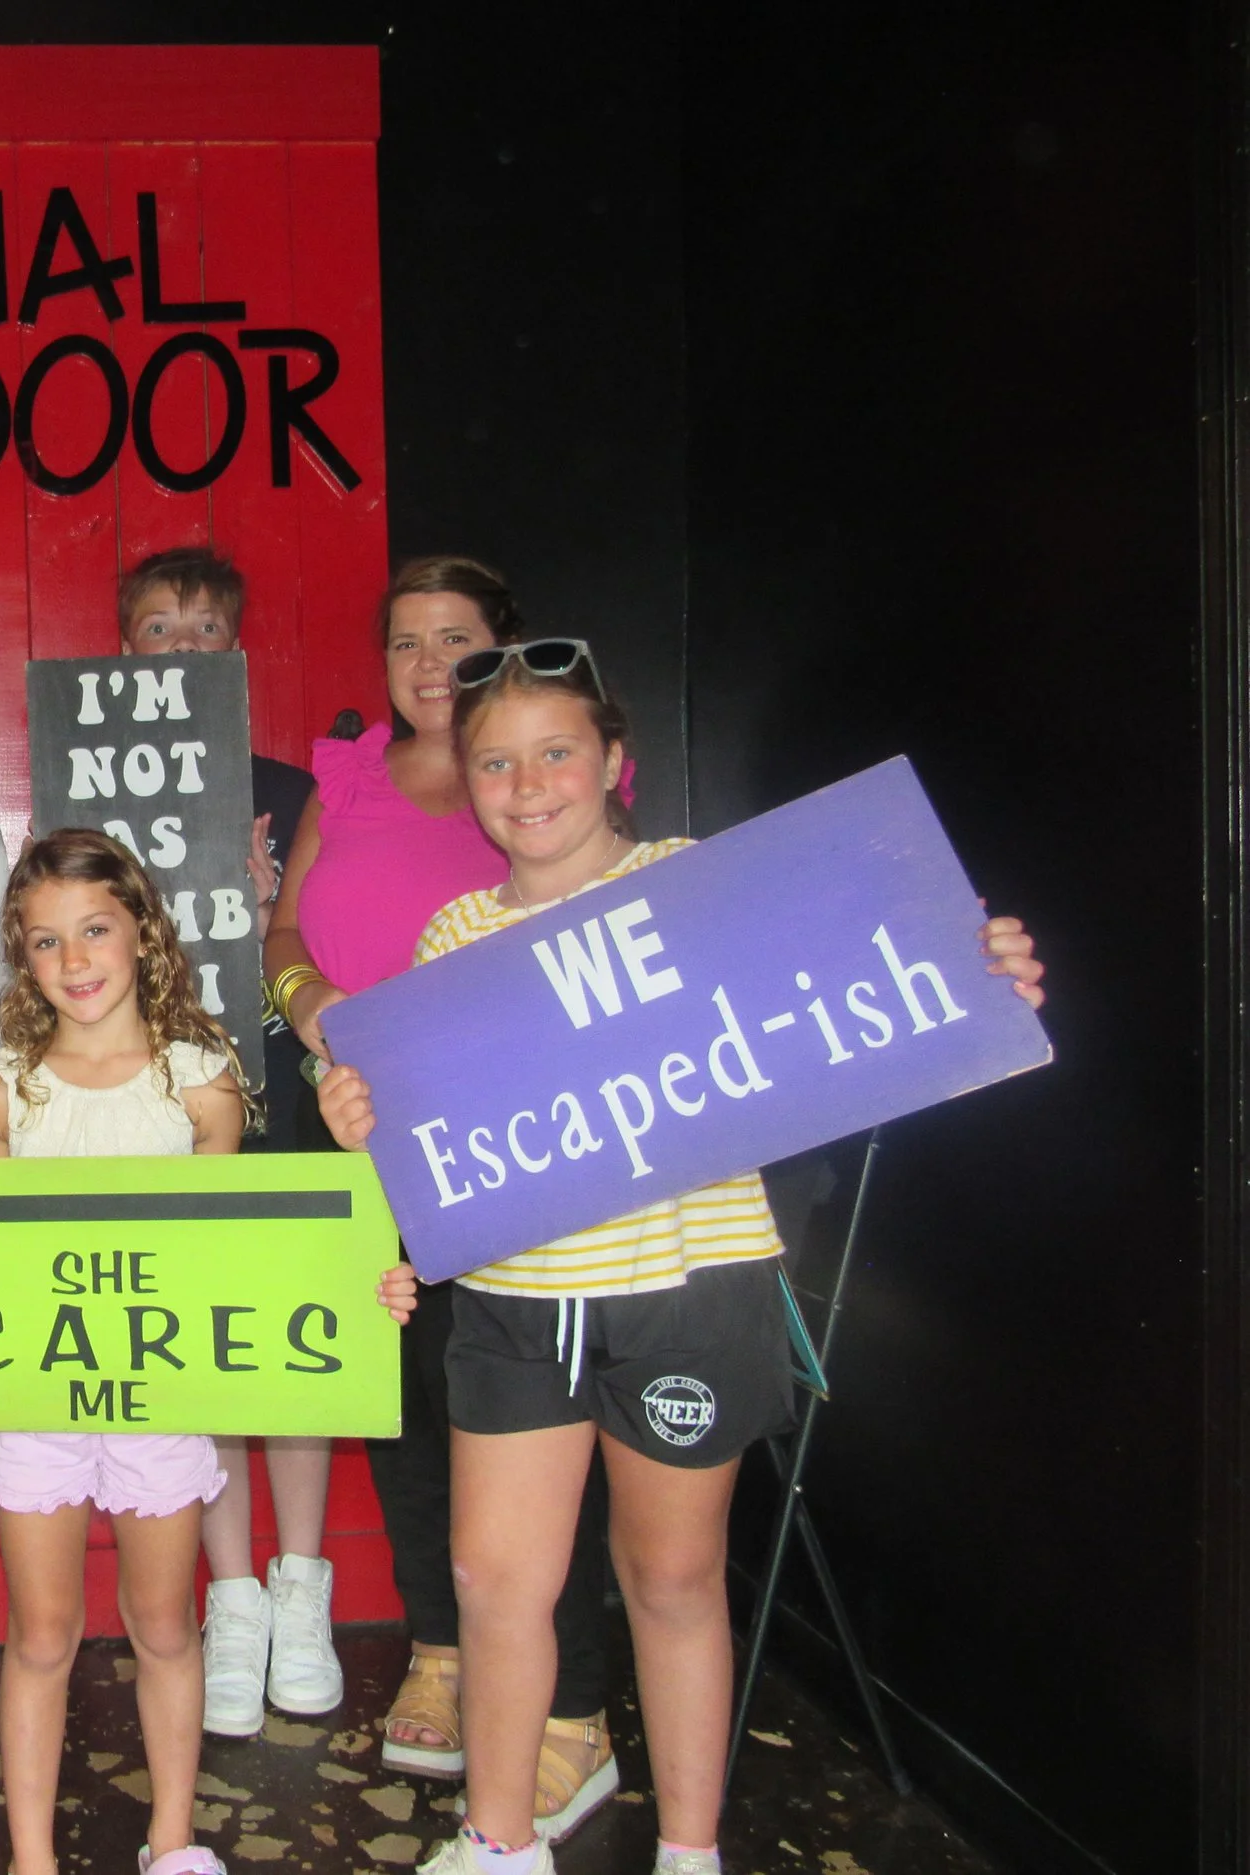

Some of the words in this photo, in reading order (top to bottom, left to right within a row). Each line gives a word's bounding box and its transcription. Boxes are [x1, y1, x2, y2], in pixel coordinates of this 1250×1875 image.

[76, 667, 192, 726] I'M
[67, 740, 207, 800] NOT
[102, 816, 187, 869] AS
[161, 888, 252, 943] MB
[531, 897, 683, 1030] WE
[412, 924, 968, 1208] Escaped-ish
[50, 1250, 159, 1295] SHE
[69, 1379, 151, 1423] ME
